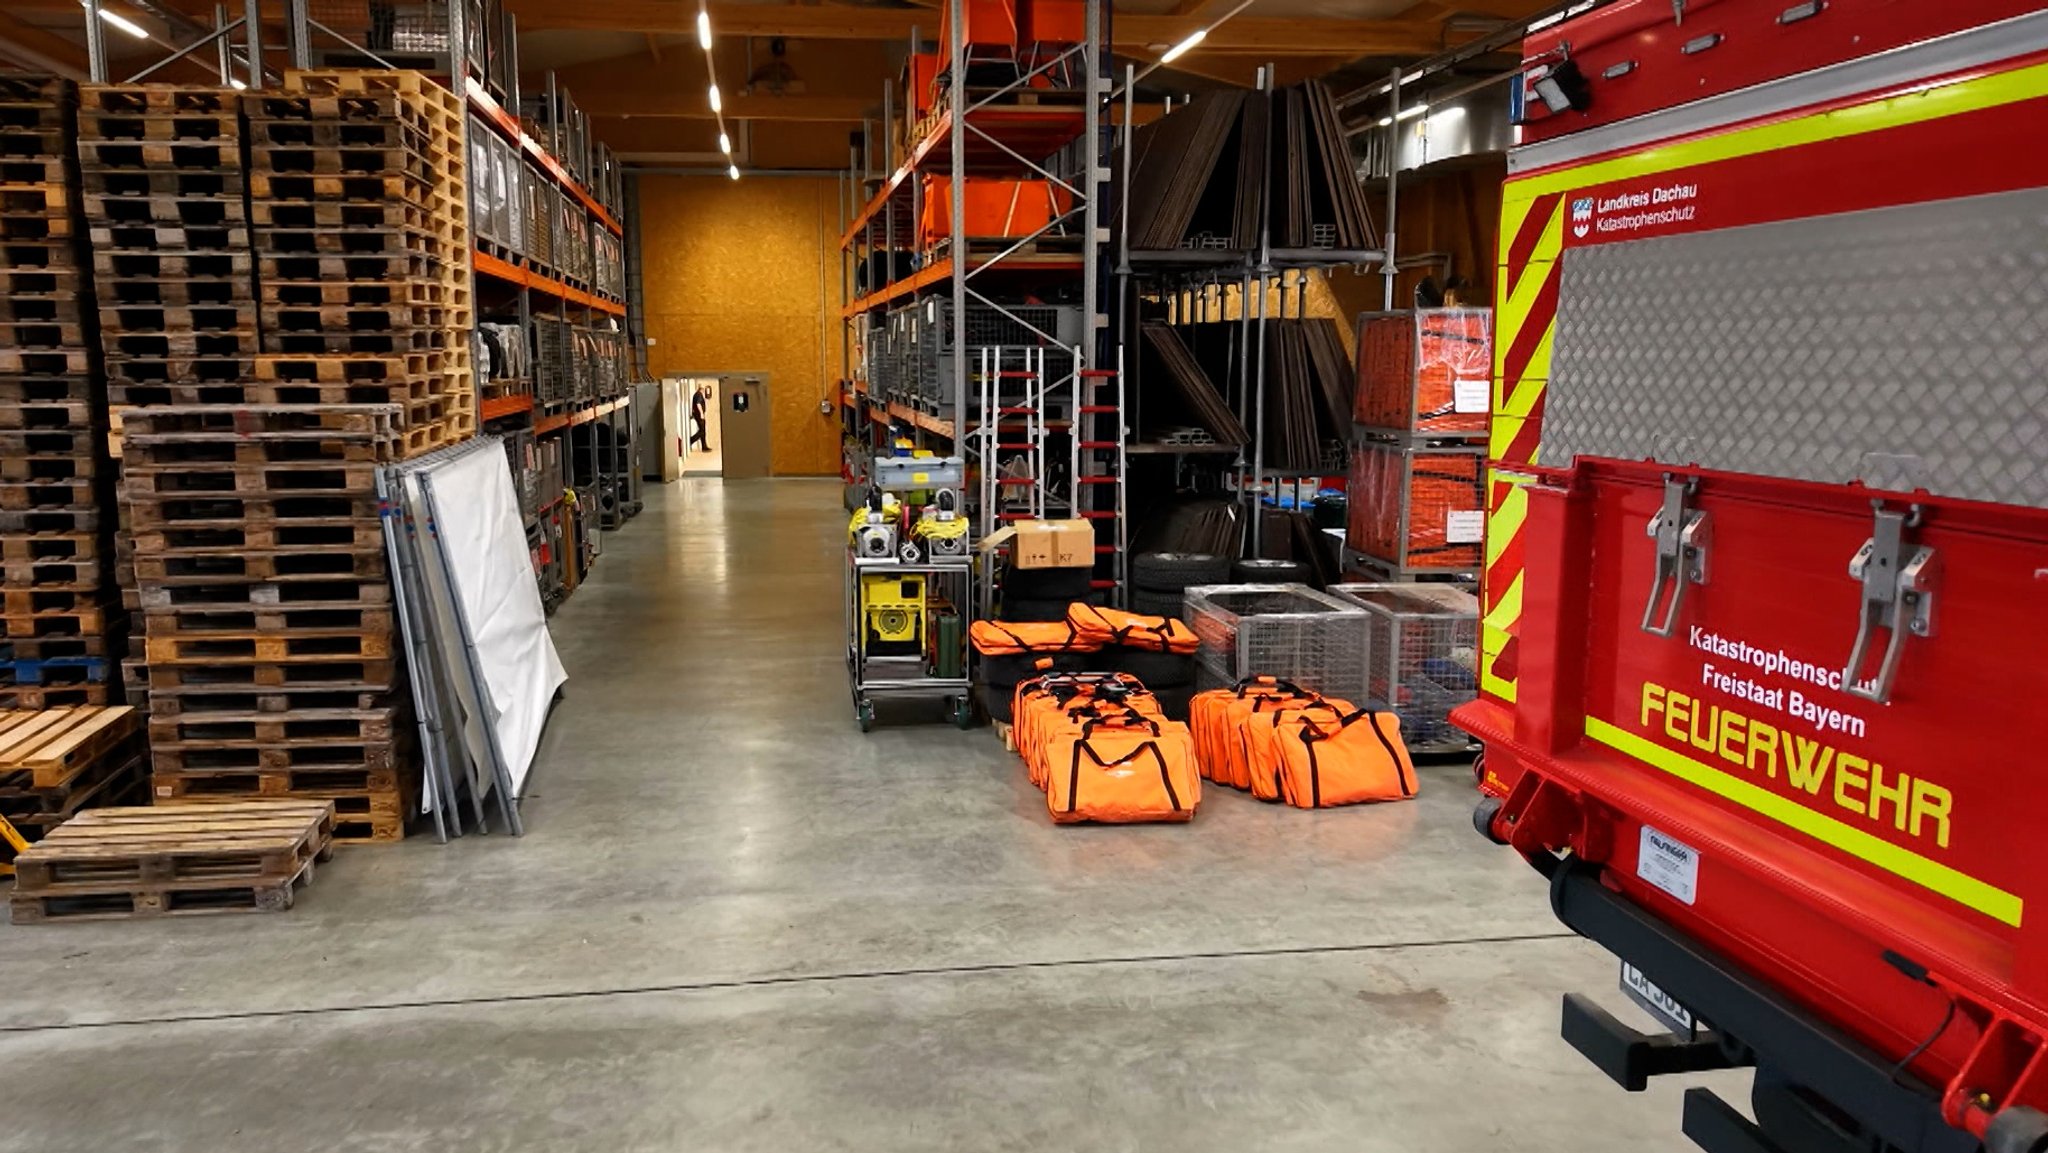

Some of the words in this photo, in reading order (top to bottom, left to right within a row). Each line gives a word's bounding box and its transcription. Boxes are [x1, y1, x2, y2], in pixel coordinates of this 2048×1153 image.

[1596, 205, 1696, 232] Katastrophenschutz
[1597, 191, 1650, 213] Landkreis
[1652, 184, 1697, 204] Dachau
[1690, 625, 1891, 706] Katastrophensc
[1702, 663, 1784, 711] Freistaat
[1788, 690, 1866, 738] Bayern
[1639, 681, 1953, 848] FEUERWEHR
